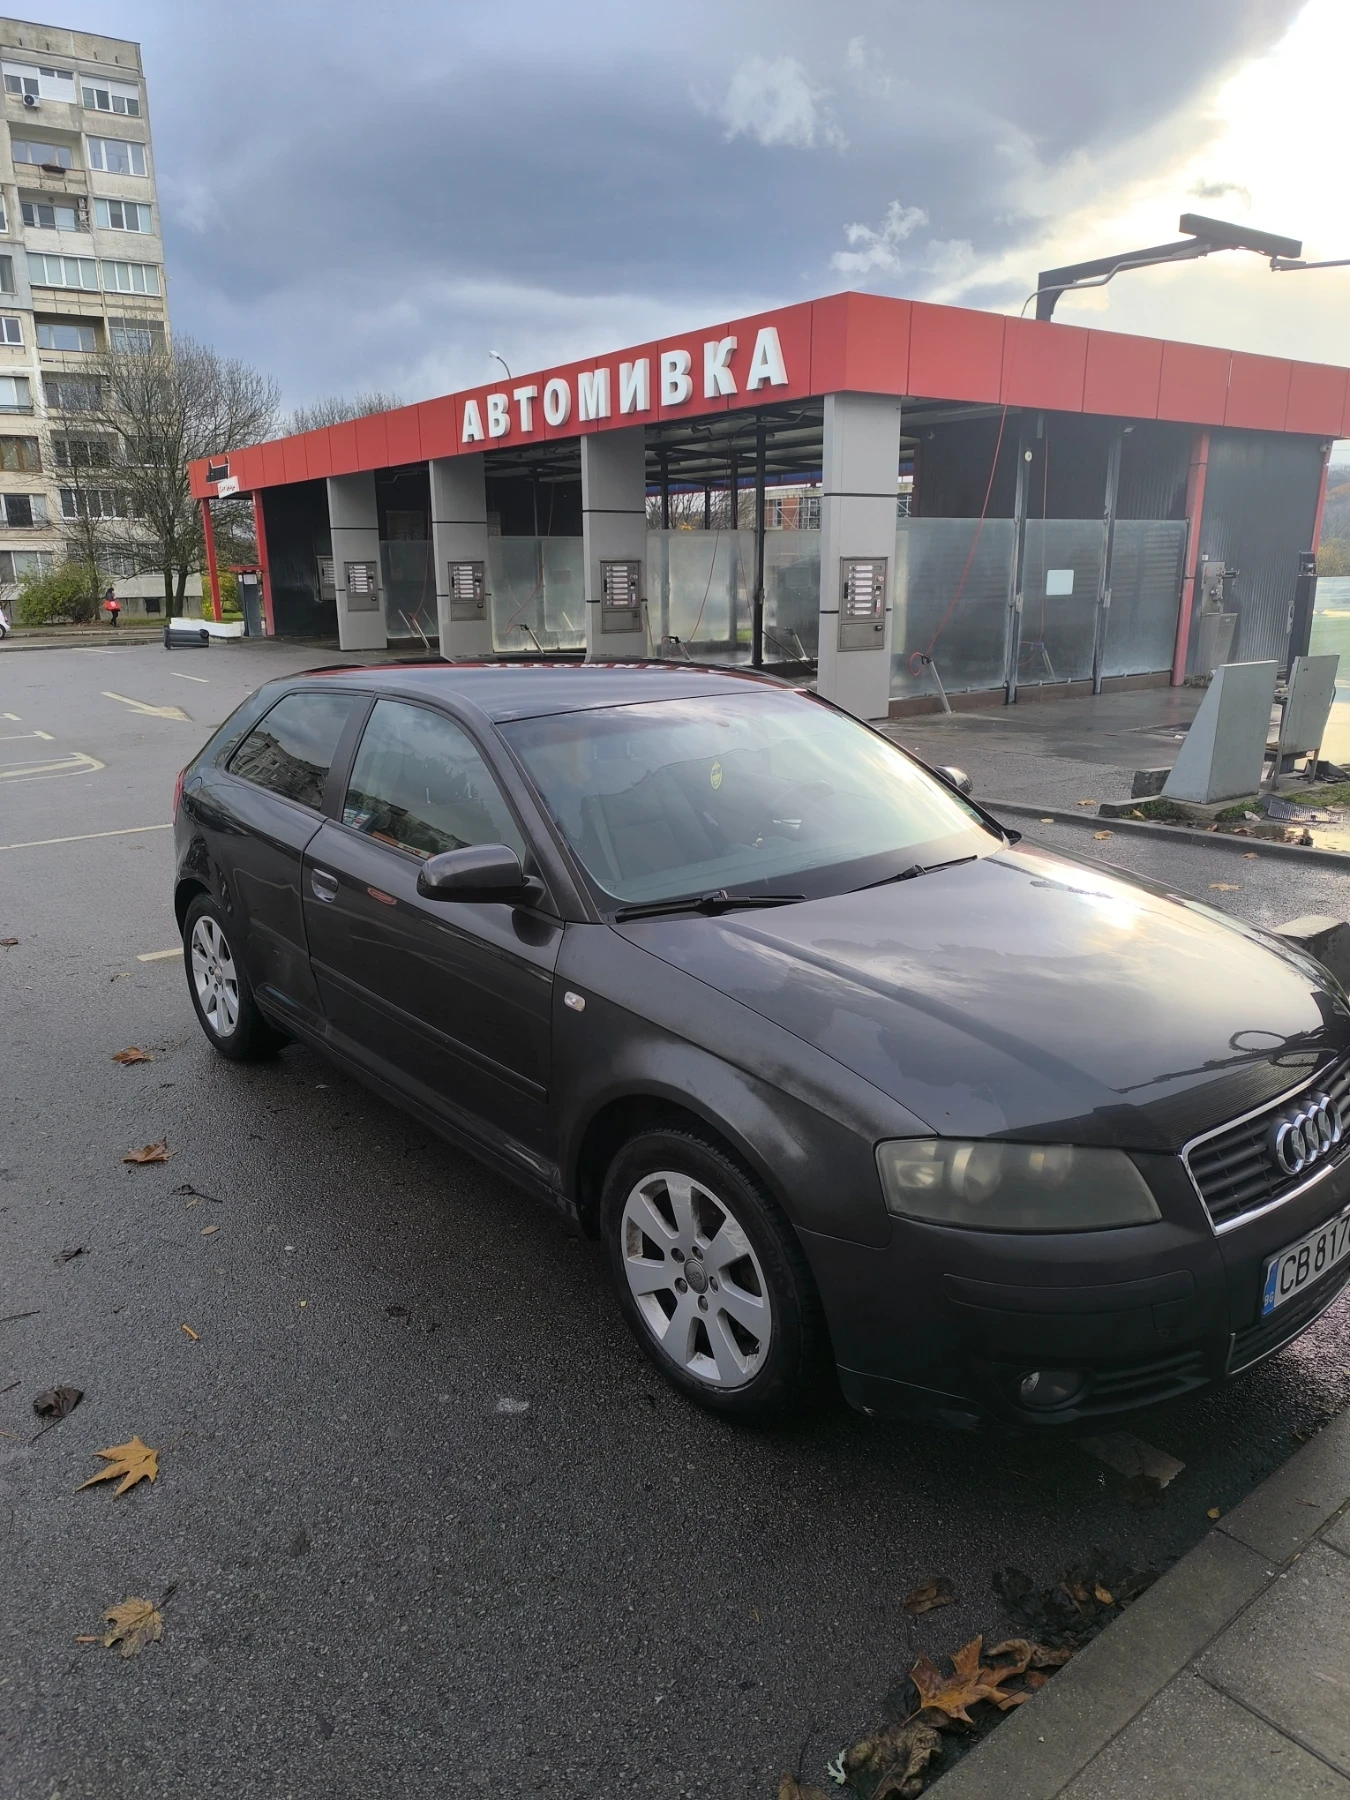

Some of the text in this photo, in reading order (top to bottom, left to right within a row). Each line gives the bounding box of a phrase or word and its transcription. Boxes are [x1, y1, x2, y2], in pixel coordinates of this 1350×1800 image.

[462, 326, 788, 443] АВТОМИВКА
[1280, 1214, 1350, 1295] CB 817
[1264, 1291, 1275, 1307] BG
